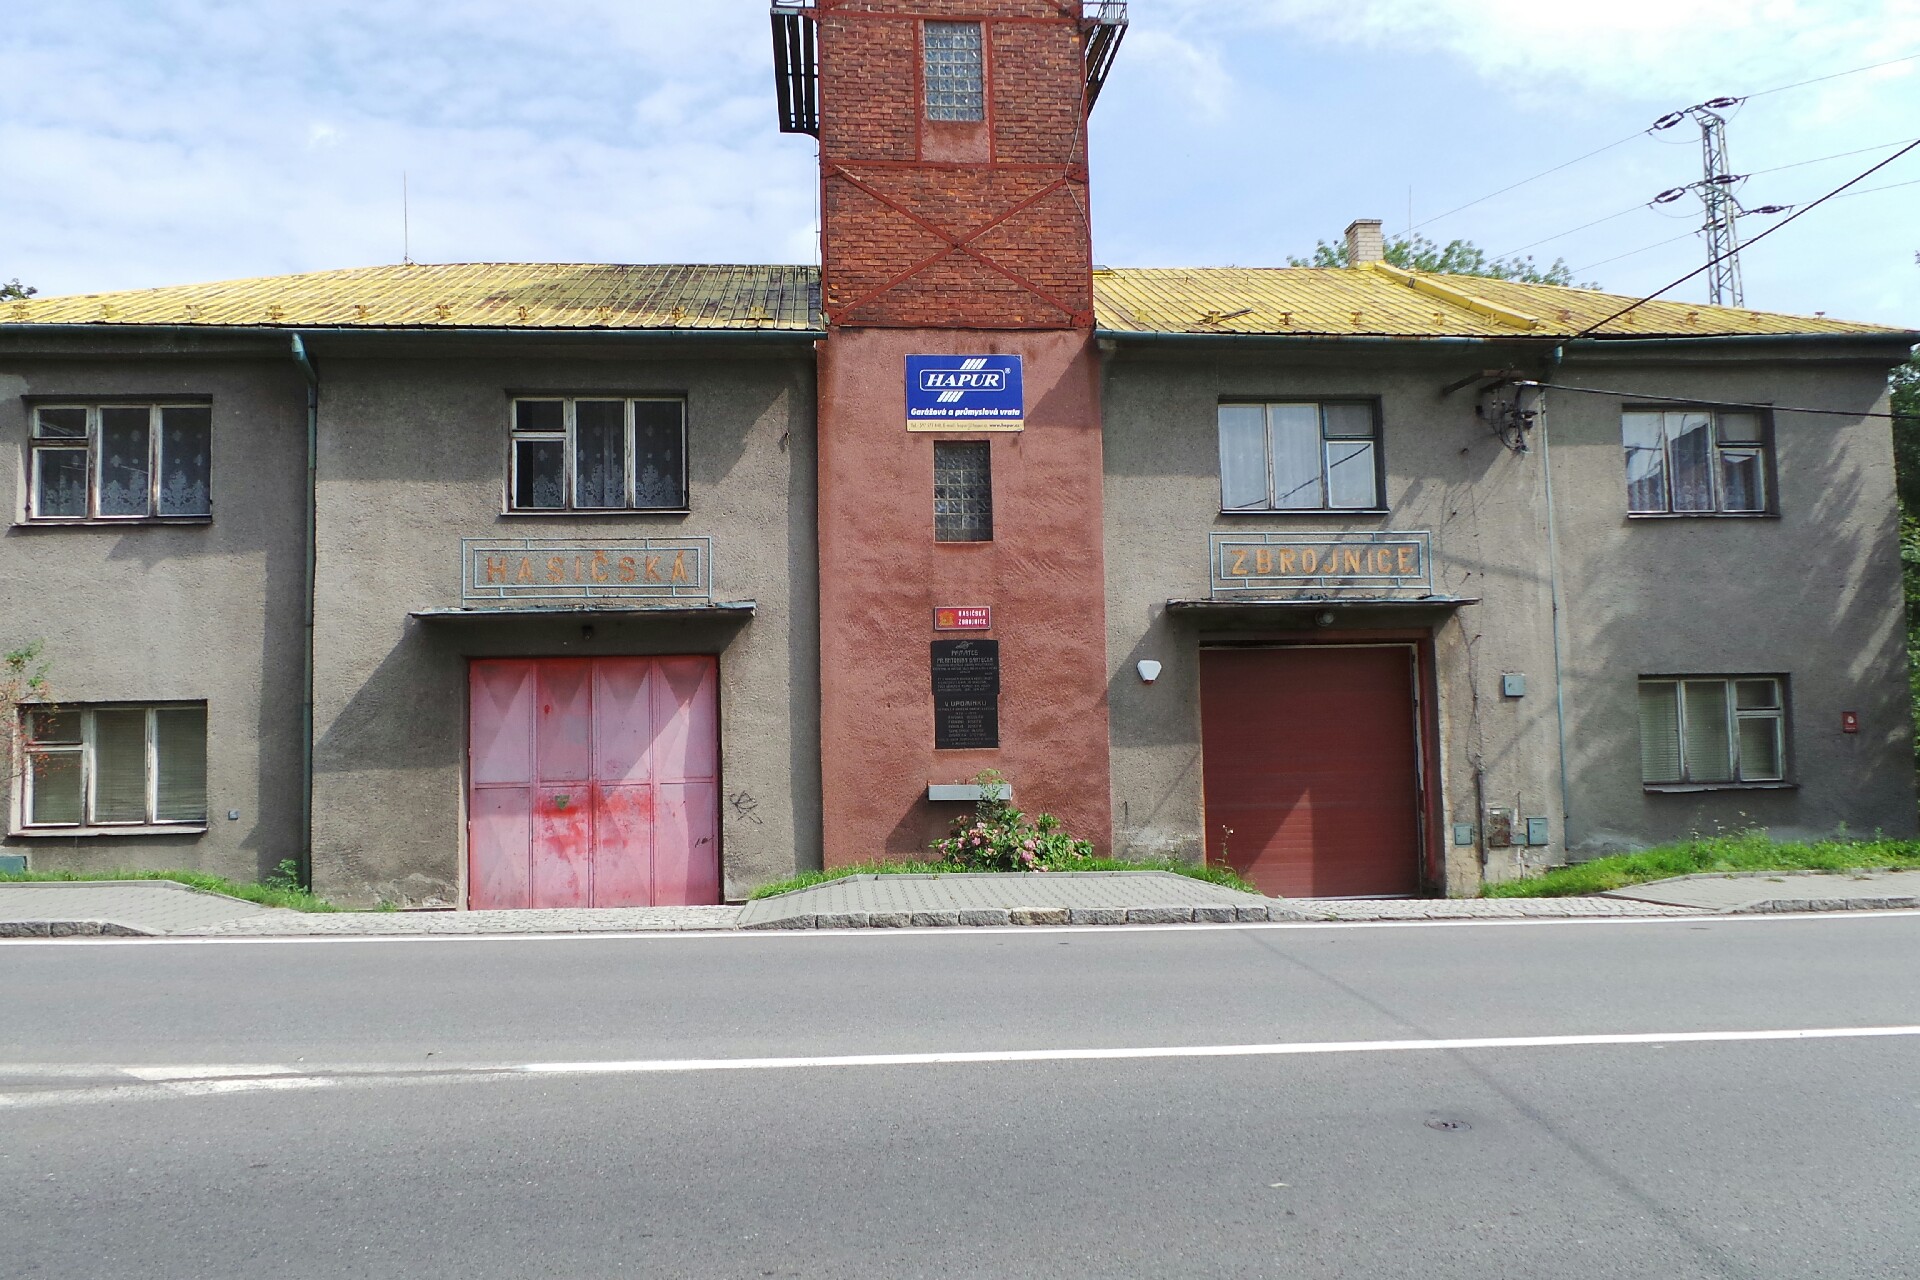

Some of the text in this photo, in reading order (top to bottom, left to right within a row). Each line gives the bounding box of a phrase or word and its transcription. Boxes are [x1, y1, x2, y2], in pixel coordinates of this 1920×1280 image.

[925, 373, 1000, 387] HAPUR
[910, 408, 947, 416] Garážová
[954, 408, 999, 417] průmyslová
[999, 408, 1020, 416] vrata
[486, 549, 689, 583] HASIČSKÁ
[1230, 547, 1414, 575] ZBROJNICE
